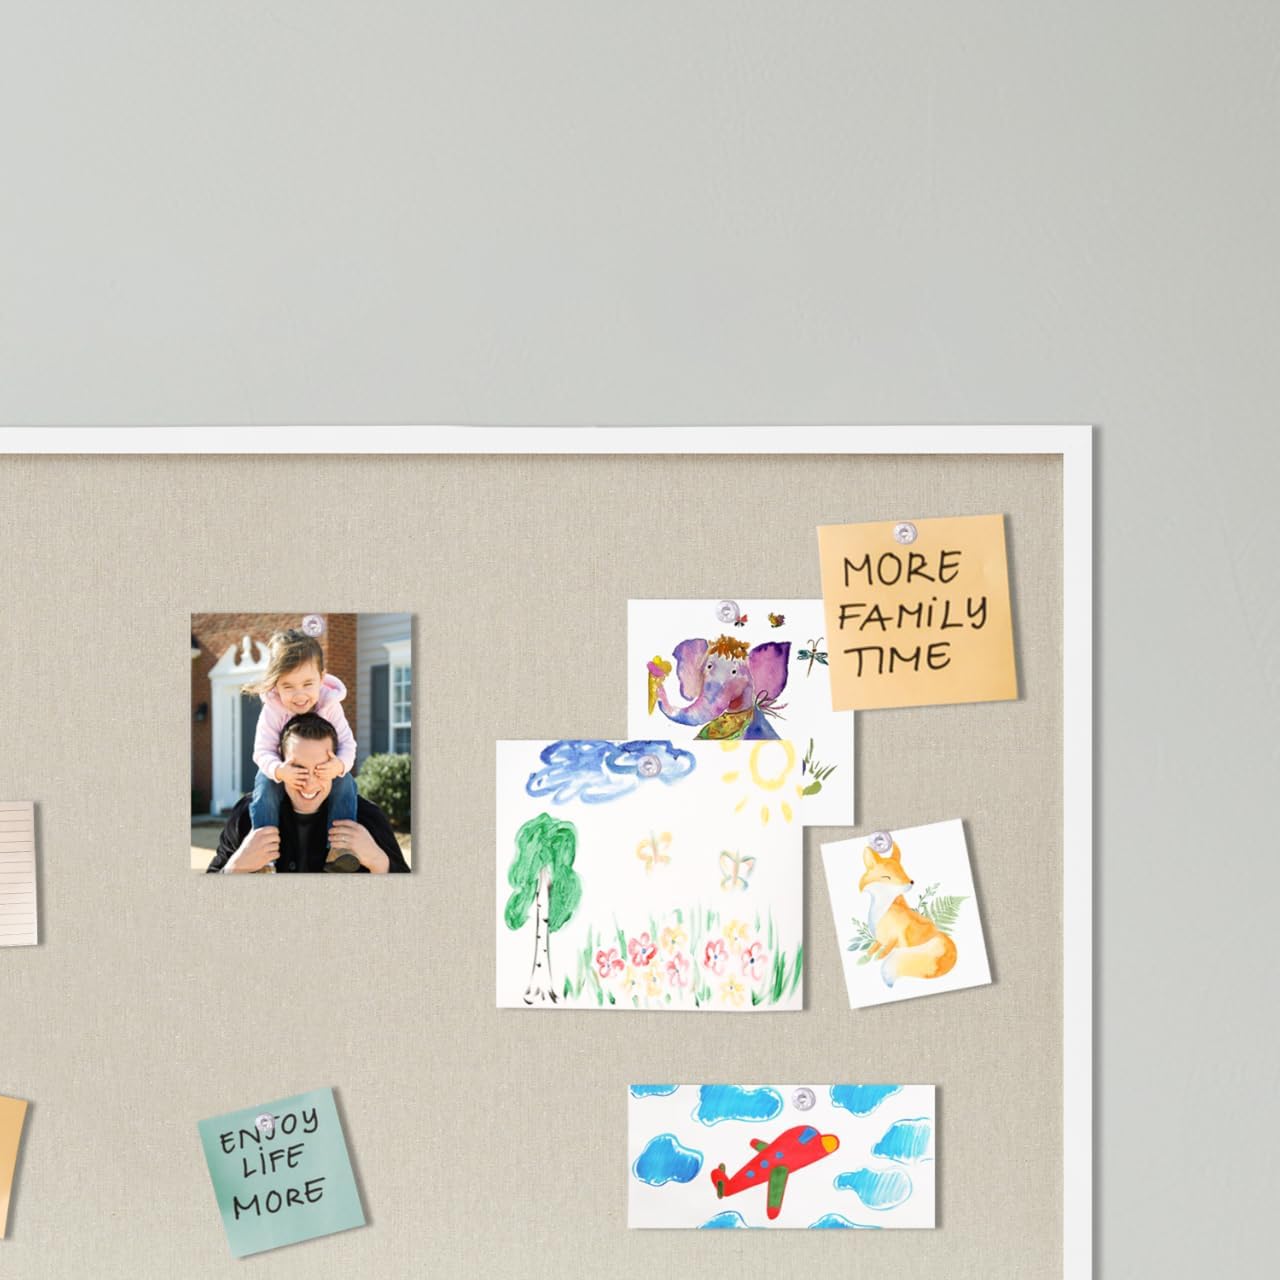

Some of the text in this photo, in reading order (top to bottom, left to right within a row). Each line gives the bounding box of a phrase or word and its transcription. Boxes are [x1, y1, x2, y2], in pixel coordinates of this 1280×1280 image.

[843, 549, 962, 587] MORE
[843, 642, 951, 677] TIME
[233, 1176, 326, 1220] MORE
